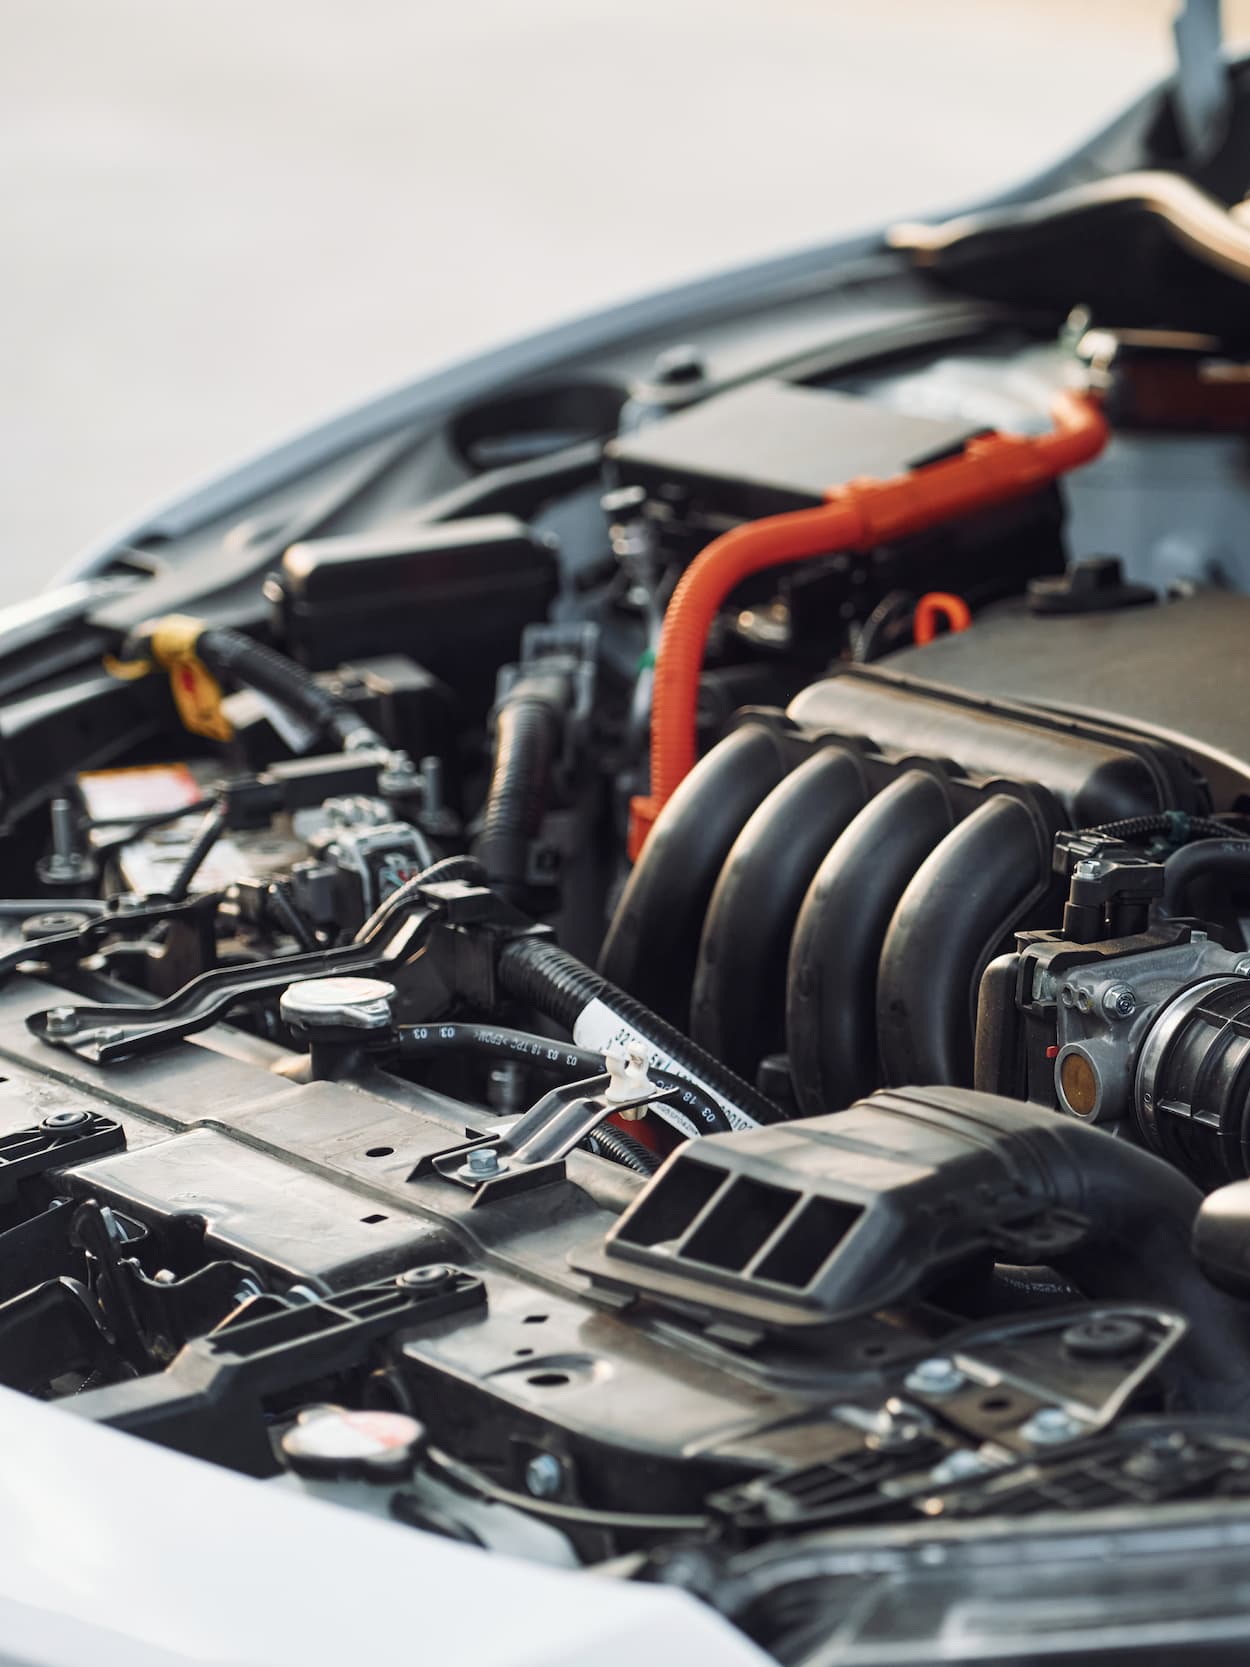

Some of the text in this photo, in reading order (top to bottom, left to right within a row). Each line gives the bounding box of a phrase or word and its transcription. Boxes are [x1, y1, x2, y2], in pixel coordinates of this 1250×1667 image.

[413, 1027, 428, 1040] 03
[440, 1026, 456, 1039] 03
[510, 1041, 530, 1054] TPC
[531, 1045, 542, 1056] 18
[547, 1049, 560, 1061] 03
[566, 1055, 578, 1067] 03
[682, 1090, 698, 1106] 18
[702, 1107, 716, 1123] 03
